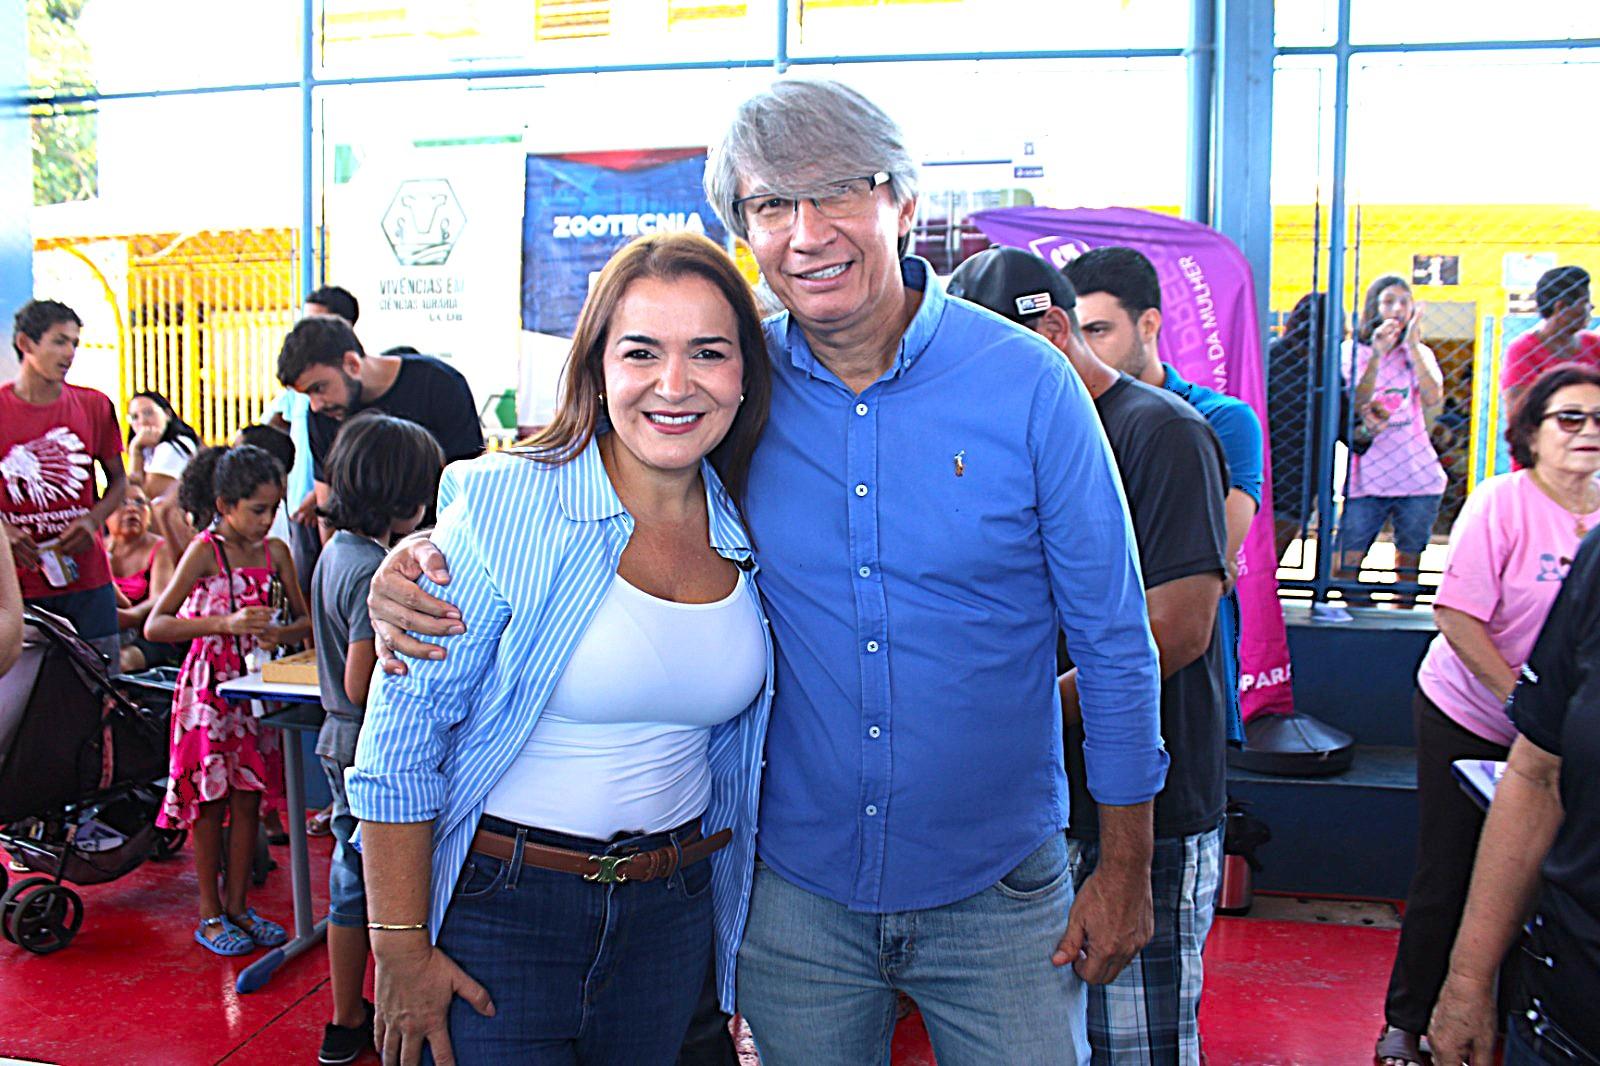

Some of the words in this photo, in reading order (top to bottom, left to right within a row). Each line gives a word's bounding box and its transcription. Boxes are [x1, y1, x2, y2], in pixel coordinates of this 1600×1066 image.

[553, 212, 705, 238] ZOOTECNIA
[1178, 255, 1218, 329] MULHER
[1206, 330, 1225, 361] DA
